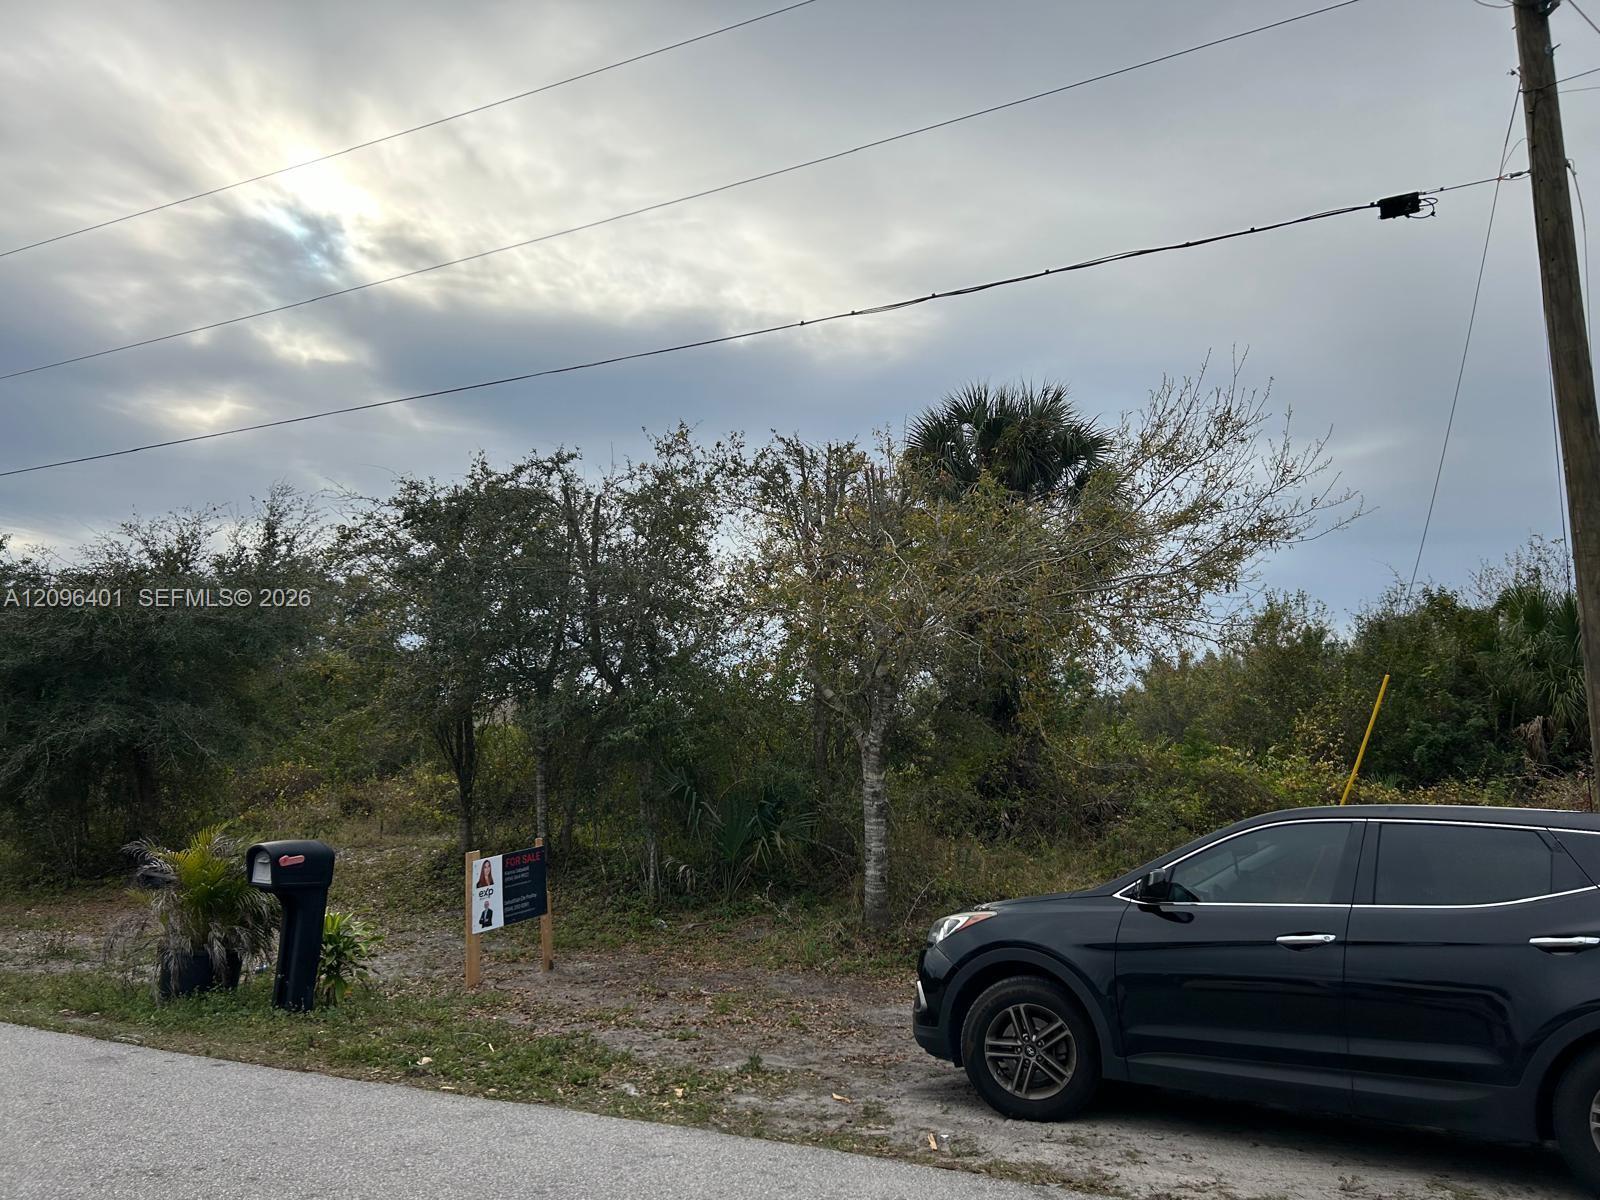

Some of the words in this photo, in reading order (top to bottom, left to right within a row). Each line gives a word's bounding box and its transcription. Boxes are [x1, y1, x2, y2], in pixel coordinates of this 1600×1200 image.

[505, 856, 521, 867] FOR
[522, 851, 541, 864] SALE
[478, 888, 494, 898] exp
